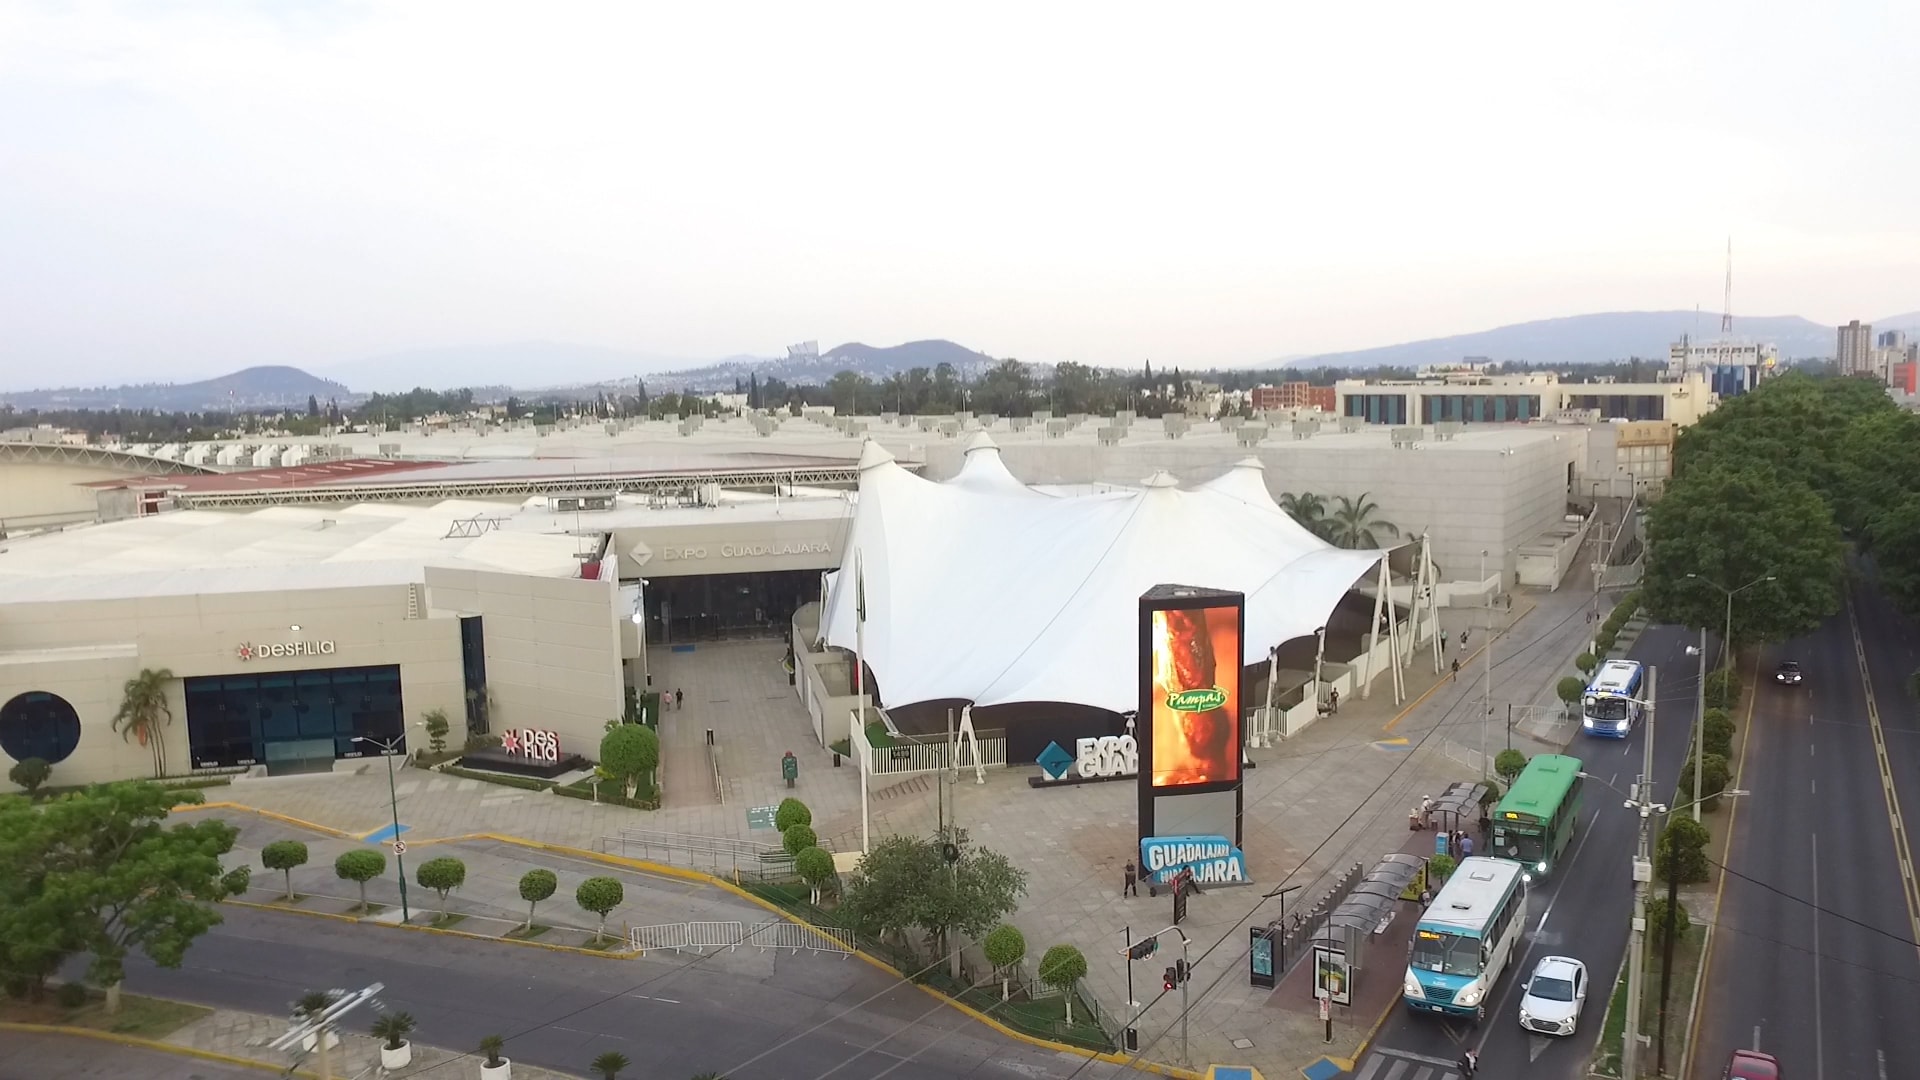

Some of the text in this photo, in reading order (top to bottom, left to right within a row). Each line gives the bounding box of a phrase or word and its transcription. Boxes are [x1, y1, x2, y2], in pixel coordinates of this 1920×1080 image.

[664, 543, 832, 561] EXPO GUADALAJARA
[1168, 692, 1222, 713] Pampas
[1076, 735, 1137, 758] EXPO
[1148, 843, 1230, 871] GUADALAJARA
